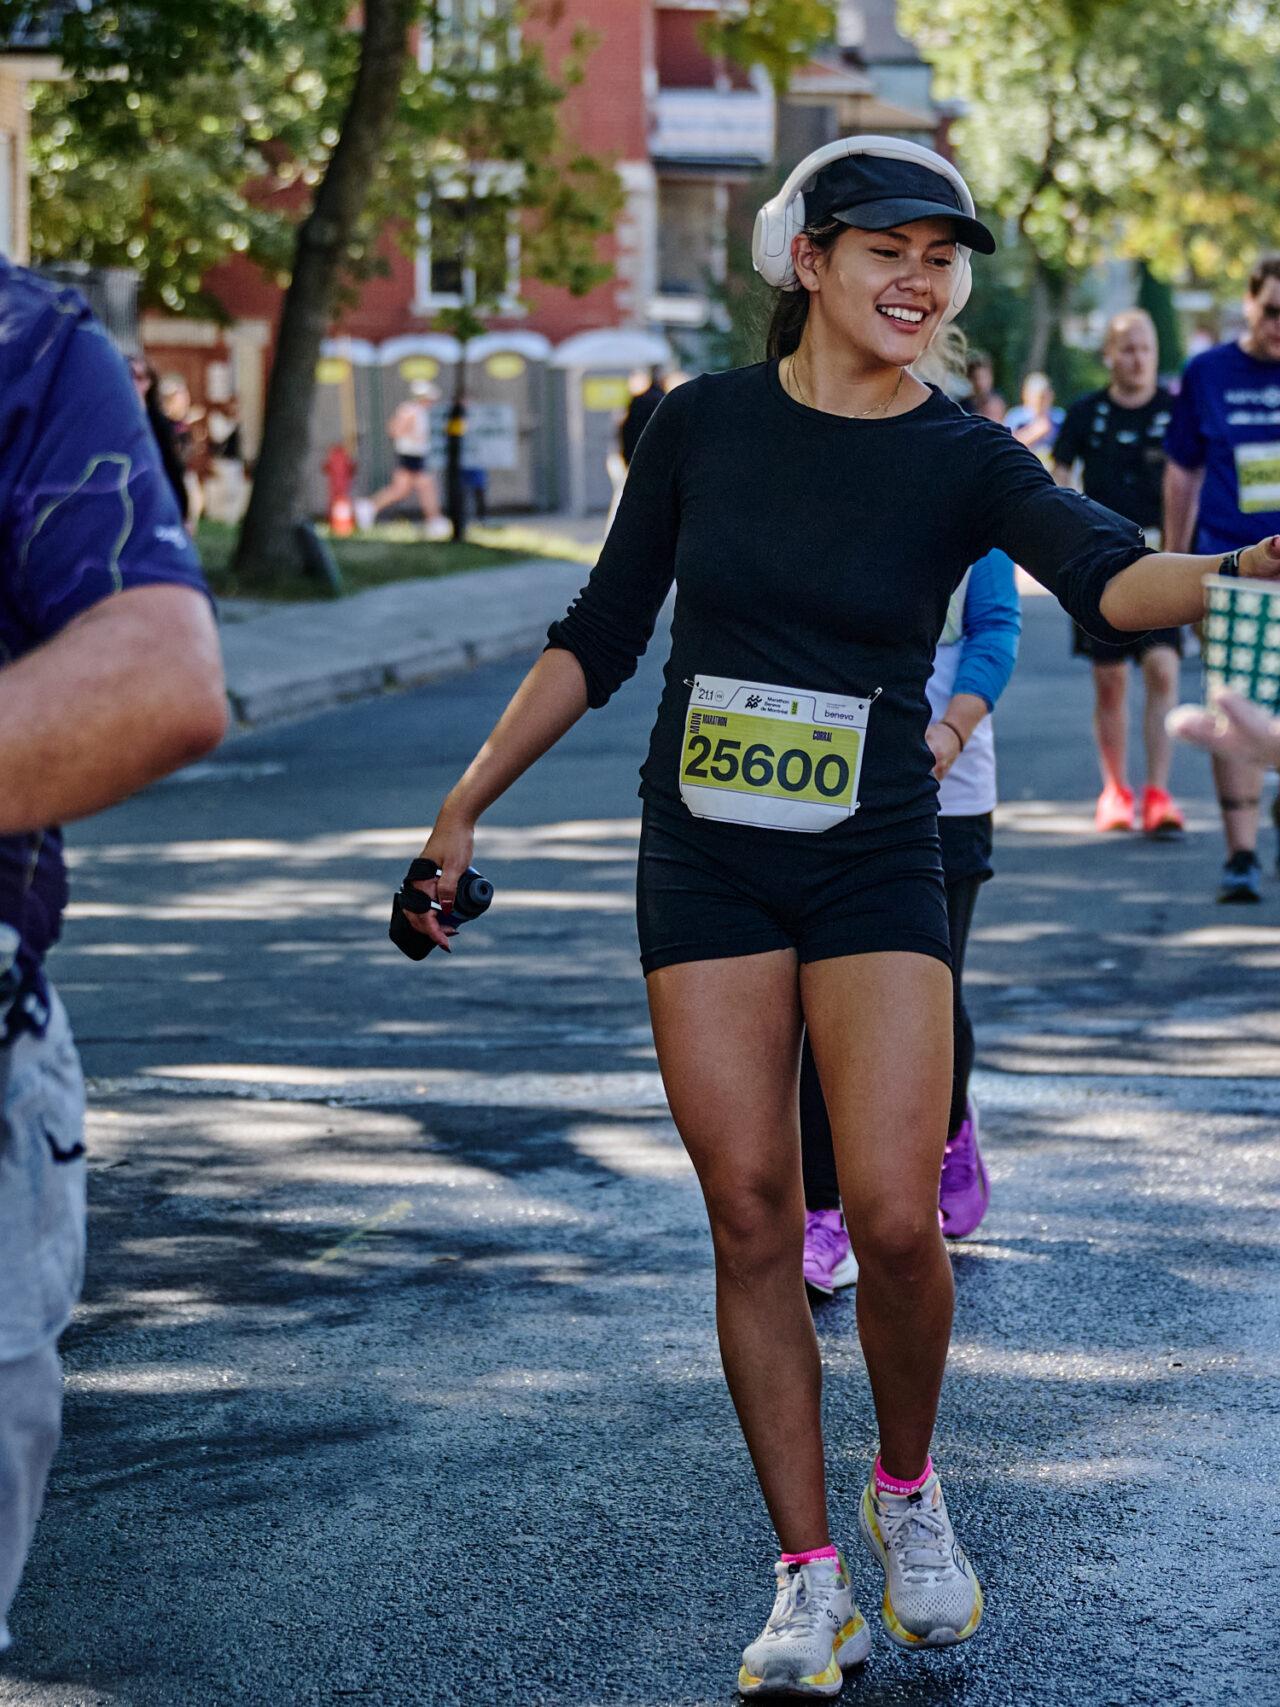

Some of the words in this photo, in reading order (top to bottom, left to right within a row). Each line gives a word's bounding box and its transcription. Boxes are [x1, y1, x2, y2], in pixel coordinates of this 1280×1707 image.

[702, 713, 728, 727] MARATHON
[824, 709, 854, 721] beneva
[684, 735, 849, 797] 25600
